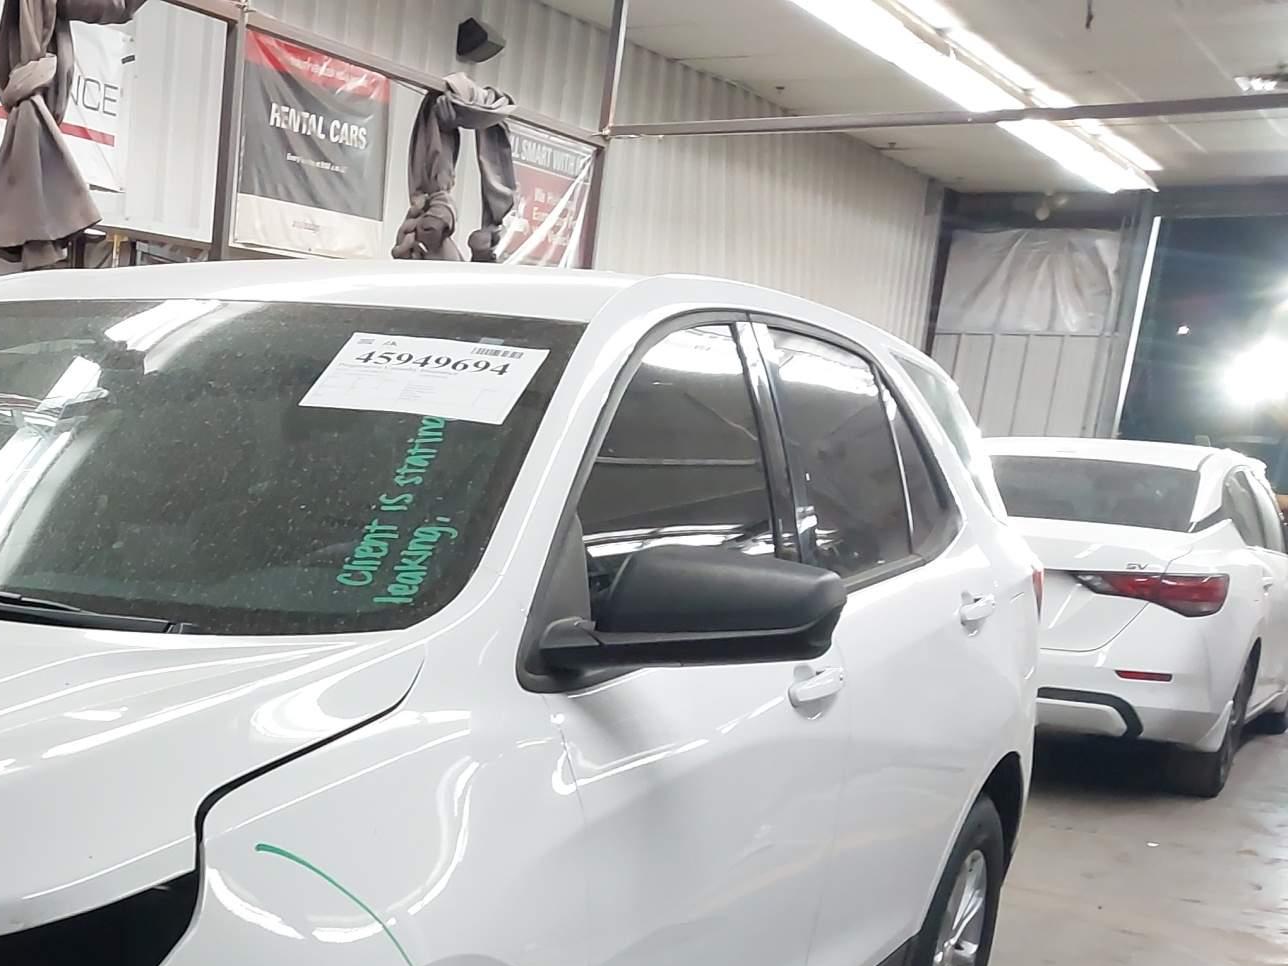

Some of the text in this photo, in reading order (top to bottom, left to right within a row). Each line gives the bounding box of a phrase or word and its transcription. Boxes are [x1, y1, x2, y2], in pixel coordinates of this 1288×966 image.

[269, 102, 368, 150] RENTAL CARS
[355, 350, 511, 376] 45949694
[336, 518, 400, 587] Client
